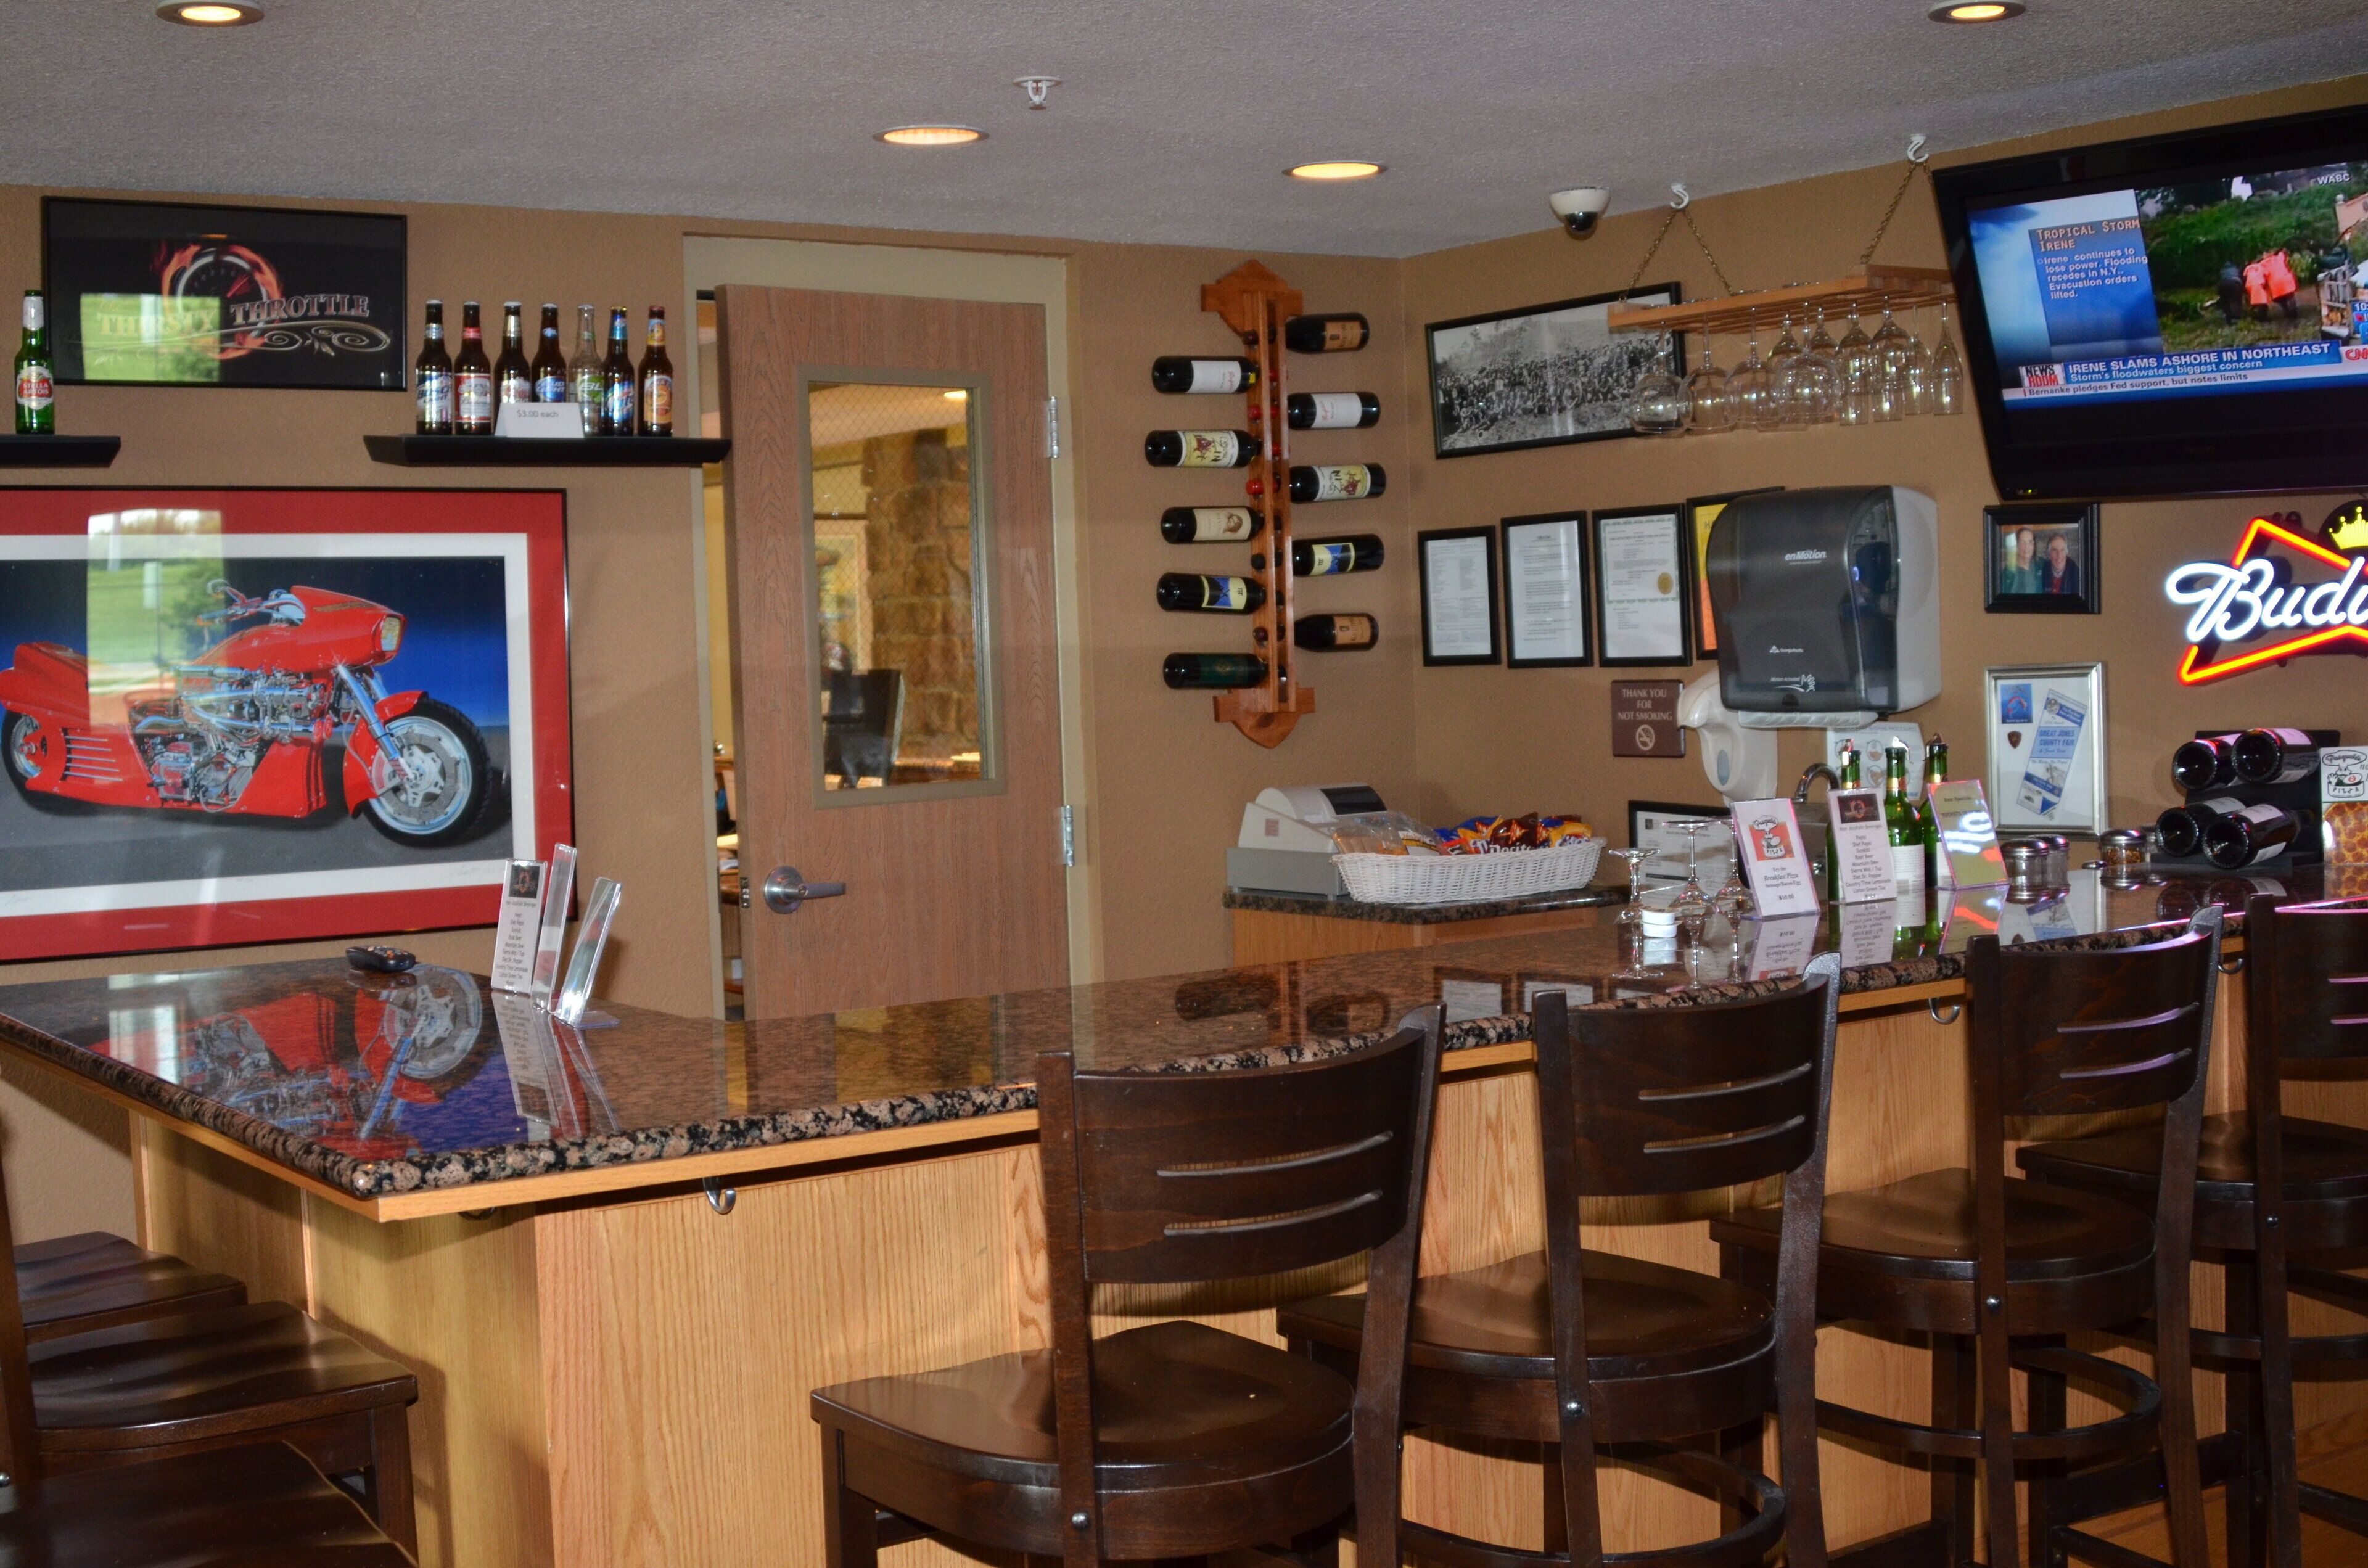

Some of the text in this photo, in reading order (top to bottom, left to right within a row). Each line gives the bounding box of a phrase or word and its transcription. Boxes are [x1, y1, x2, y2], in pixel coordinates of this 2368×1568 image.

[2317, 173, 2350, 184] WABC
[2037, 219, 2140, 240] TROPICAL STORM
[2040, 239, 2076, 252] IRENE
[2044, 247, 2135, 265] Irene continues to
[2045, 264, 2066, 273] lose
[2105, 255, 2148, 266] Flooding
[2048, 271, 2086, 282] recedes
[2049, 275, 2137, 290] Evacuation orders
[2051, 290, 2078, 300] lifted.
[230, 294, 370, 326] THROTTLE
[2068, 343, 2330, 374] IRENE SLAMS ASHORE IN NORTHEAST
[2345, 348, 2368, 361] CN
[2025, 365, 2055, 376] NEWS
[2071, 361, 2263, 382] Storm's floodwaters biggest concern
[2027, 374, 2058, 387] ROOM
[2029, 387, 2070, 396] Bernanke
[2073, 384, 2108, 394] pledges
[2111, 381, 2127, 390] Fed
[2171, 377, 2187, 385] but
[2190, 376, 2218, 384] notes
[2220, 372, 2248, 382] limits
[517, 409, 559, 418] $3.00 each
[1785, 549, 1826, 560] enMotion
[1622, 688, 1667, 697] THANK YOU
[1637, 700, 1652, 708] FOR
[1618, 712, 1672, 720] NOT SMOKING
[2333, 786, 2359, 794] PIZZA
[1489, 842, 1534, 853] Dorit
